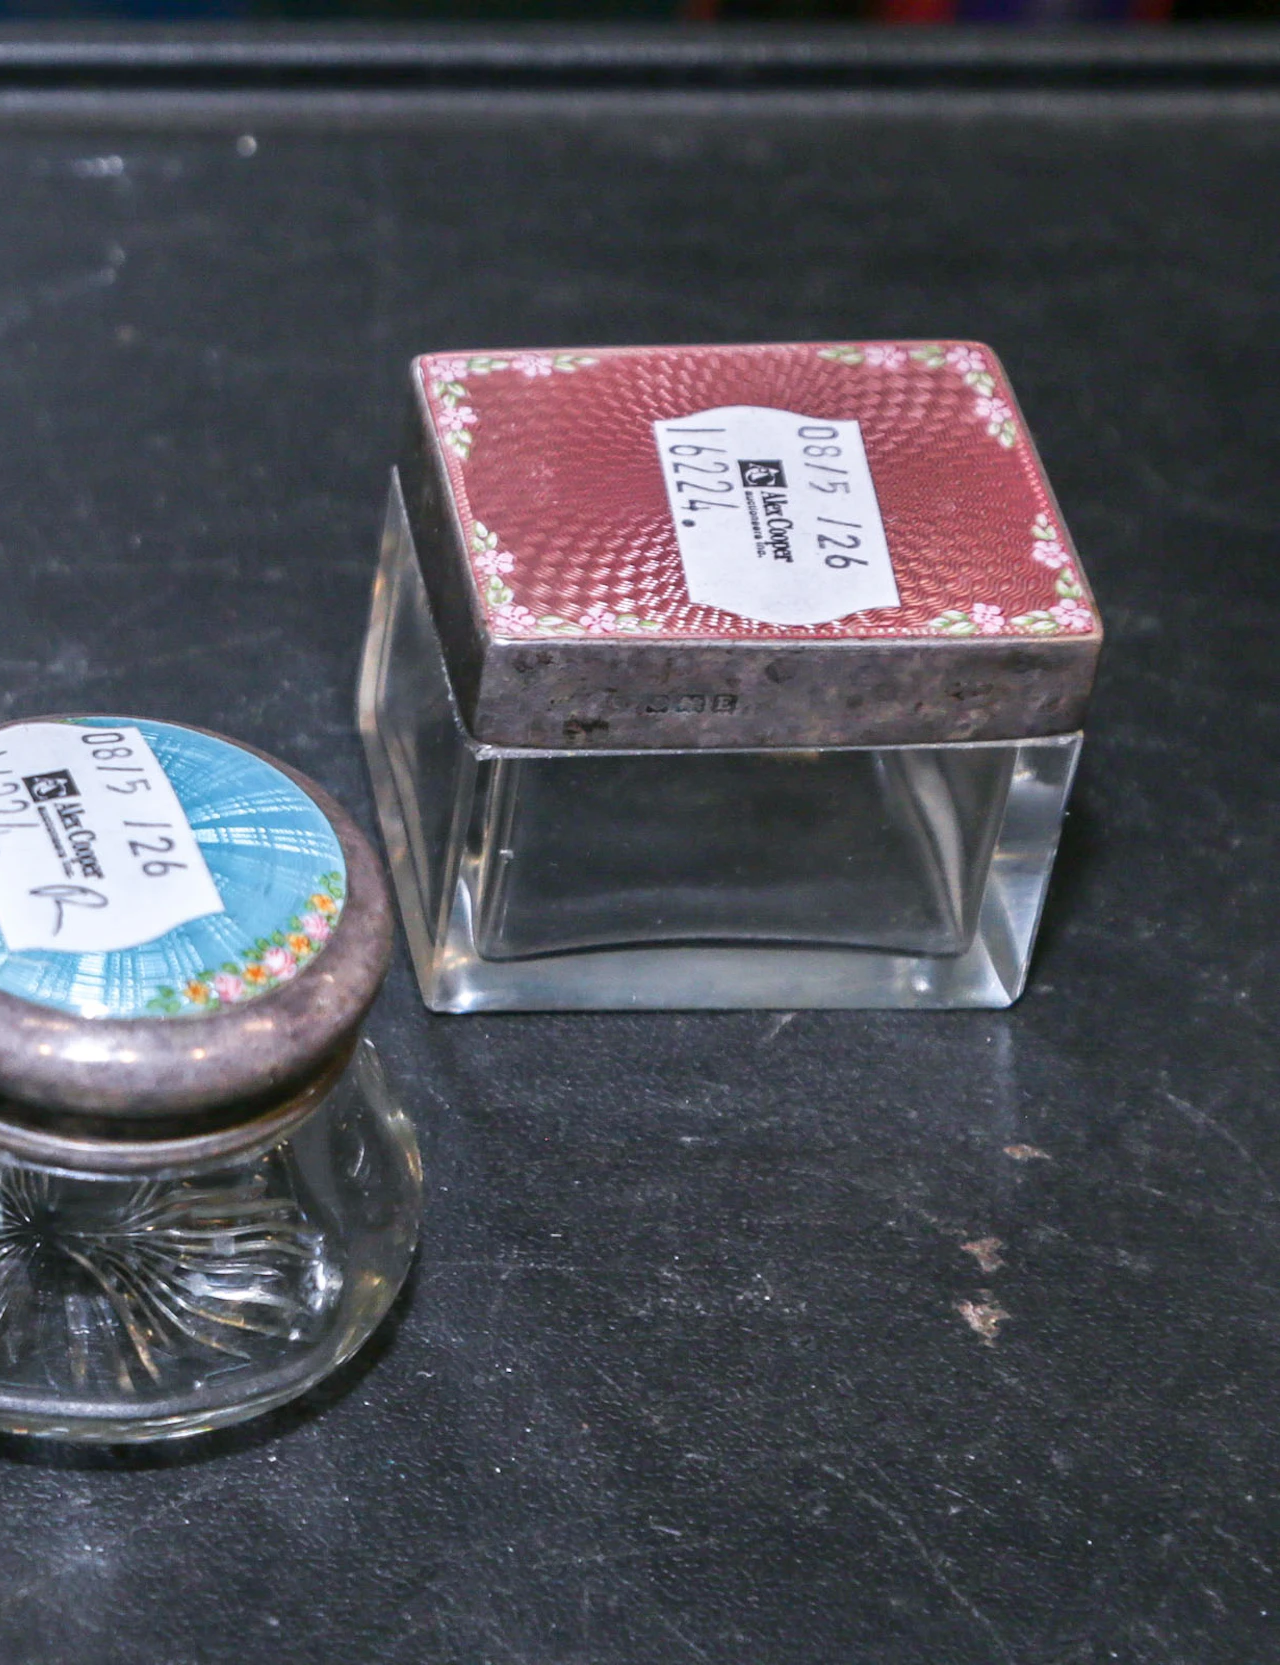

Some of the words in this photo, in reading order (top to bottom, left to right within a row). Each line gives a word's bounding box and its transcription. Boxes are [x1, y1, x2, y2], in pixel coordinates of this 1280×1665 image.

[761, 491, 788, 517] Alex
[766, 516, 793, 563] Cooper
[52, 802, 85, 831] Alex
[67, 828, 105, 879] Cooper
